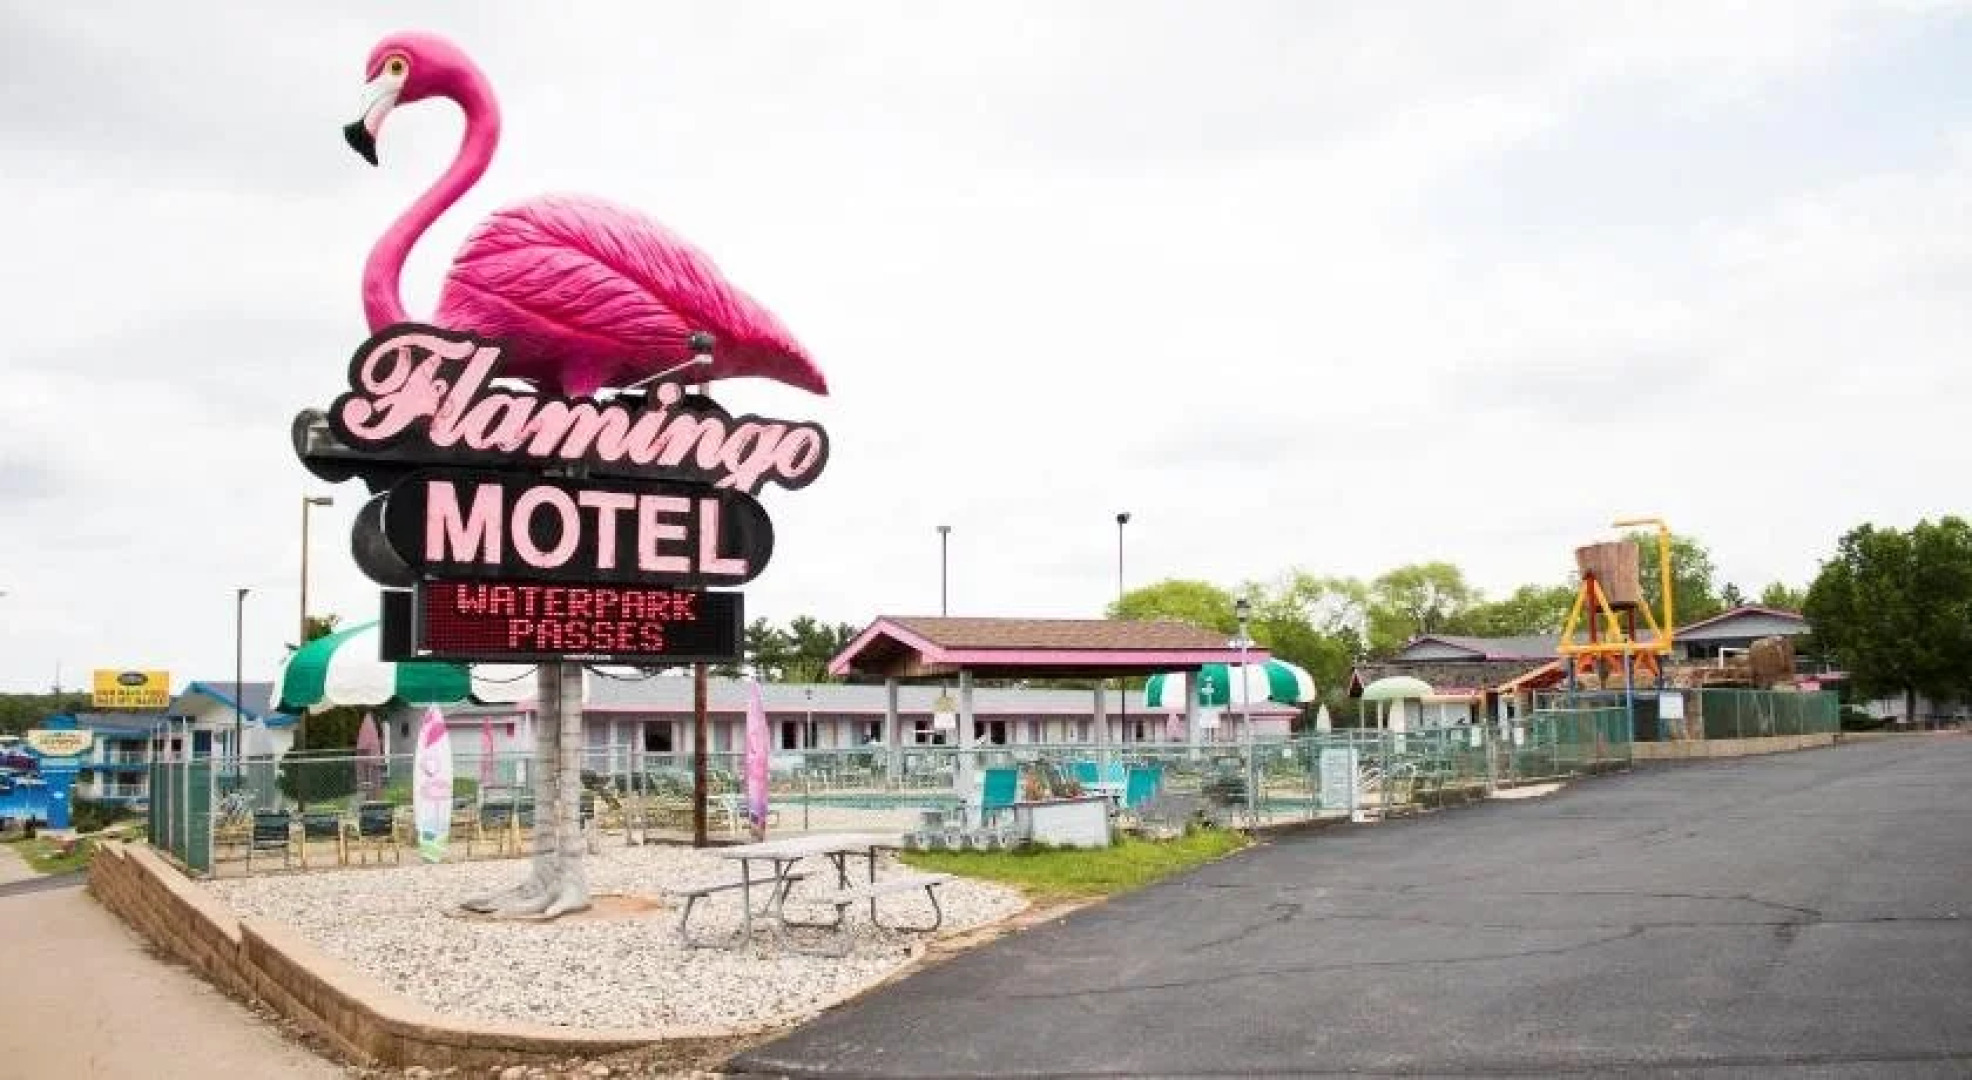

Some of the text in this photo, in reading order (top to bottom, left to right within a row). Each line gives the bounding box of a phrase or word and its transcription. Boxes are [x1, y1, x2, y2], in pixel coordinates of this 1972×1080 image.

[342, 333, 822, 490] Flamingo
[424, 480, 748, 576] MOTEL
[457, 584, 696, 621] WATERPARK
[508, 619, 665, 651] PASSES
